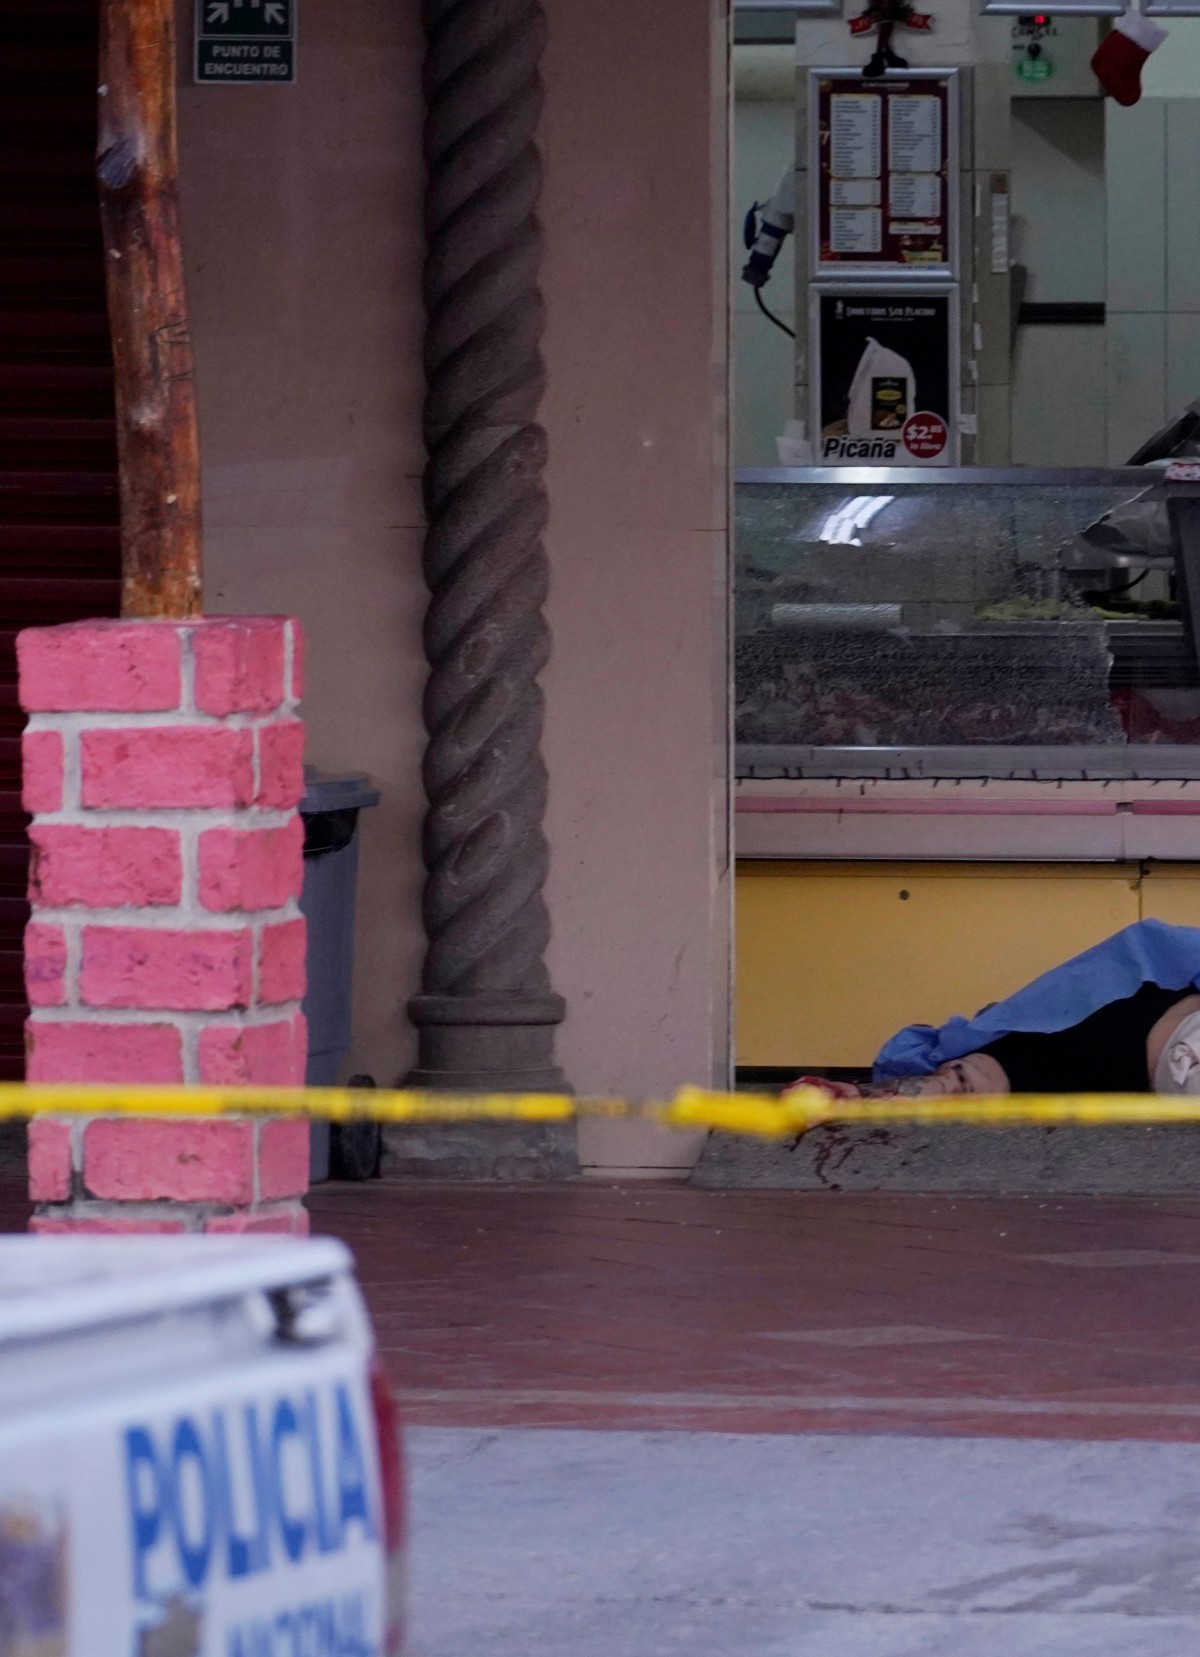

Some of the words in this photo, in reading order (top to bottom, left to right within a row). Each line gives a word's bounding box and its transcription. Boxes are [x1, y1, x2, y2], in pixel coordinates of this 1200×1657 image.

[211, 45, 260, 58] PUNTO
[263, 45, 281, 58] DE
[204, 62, 289, 76] ENCUENTRO
[823, 437, 897, 459] Picaña
[122, 1381, 378, 1600] POLICIA
